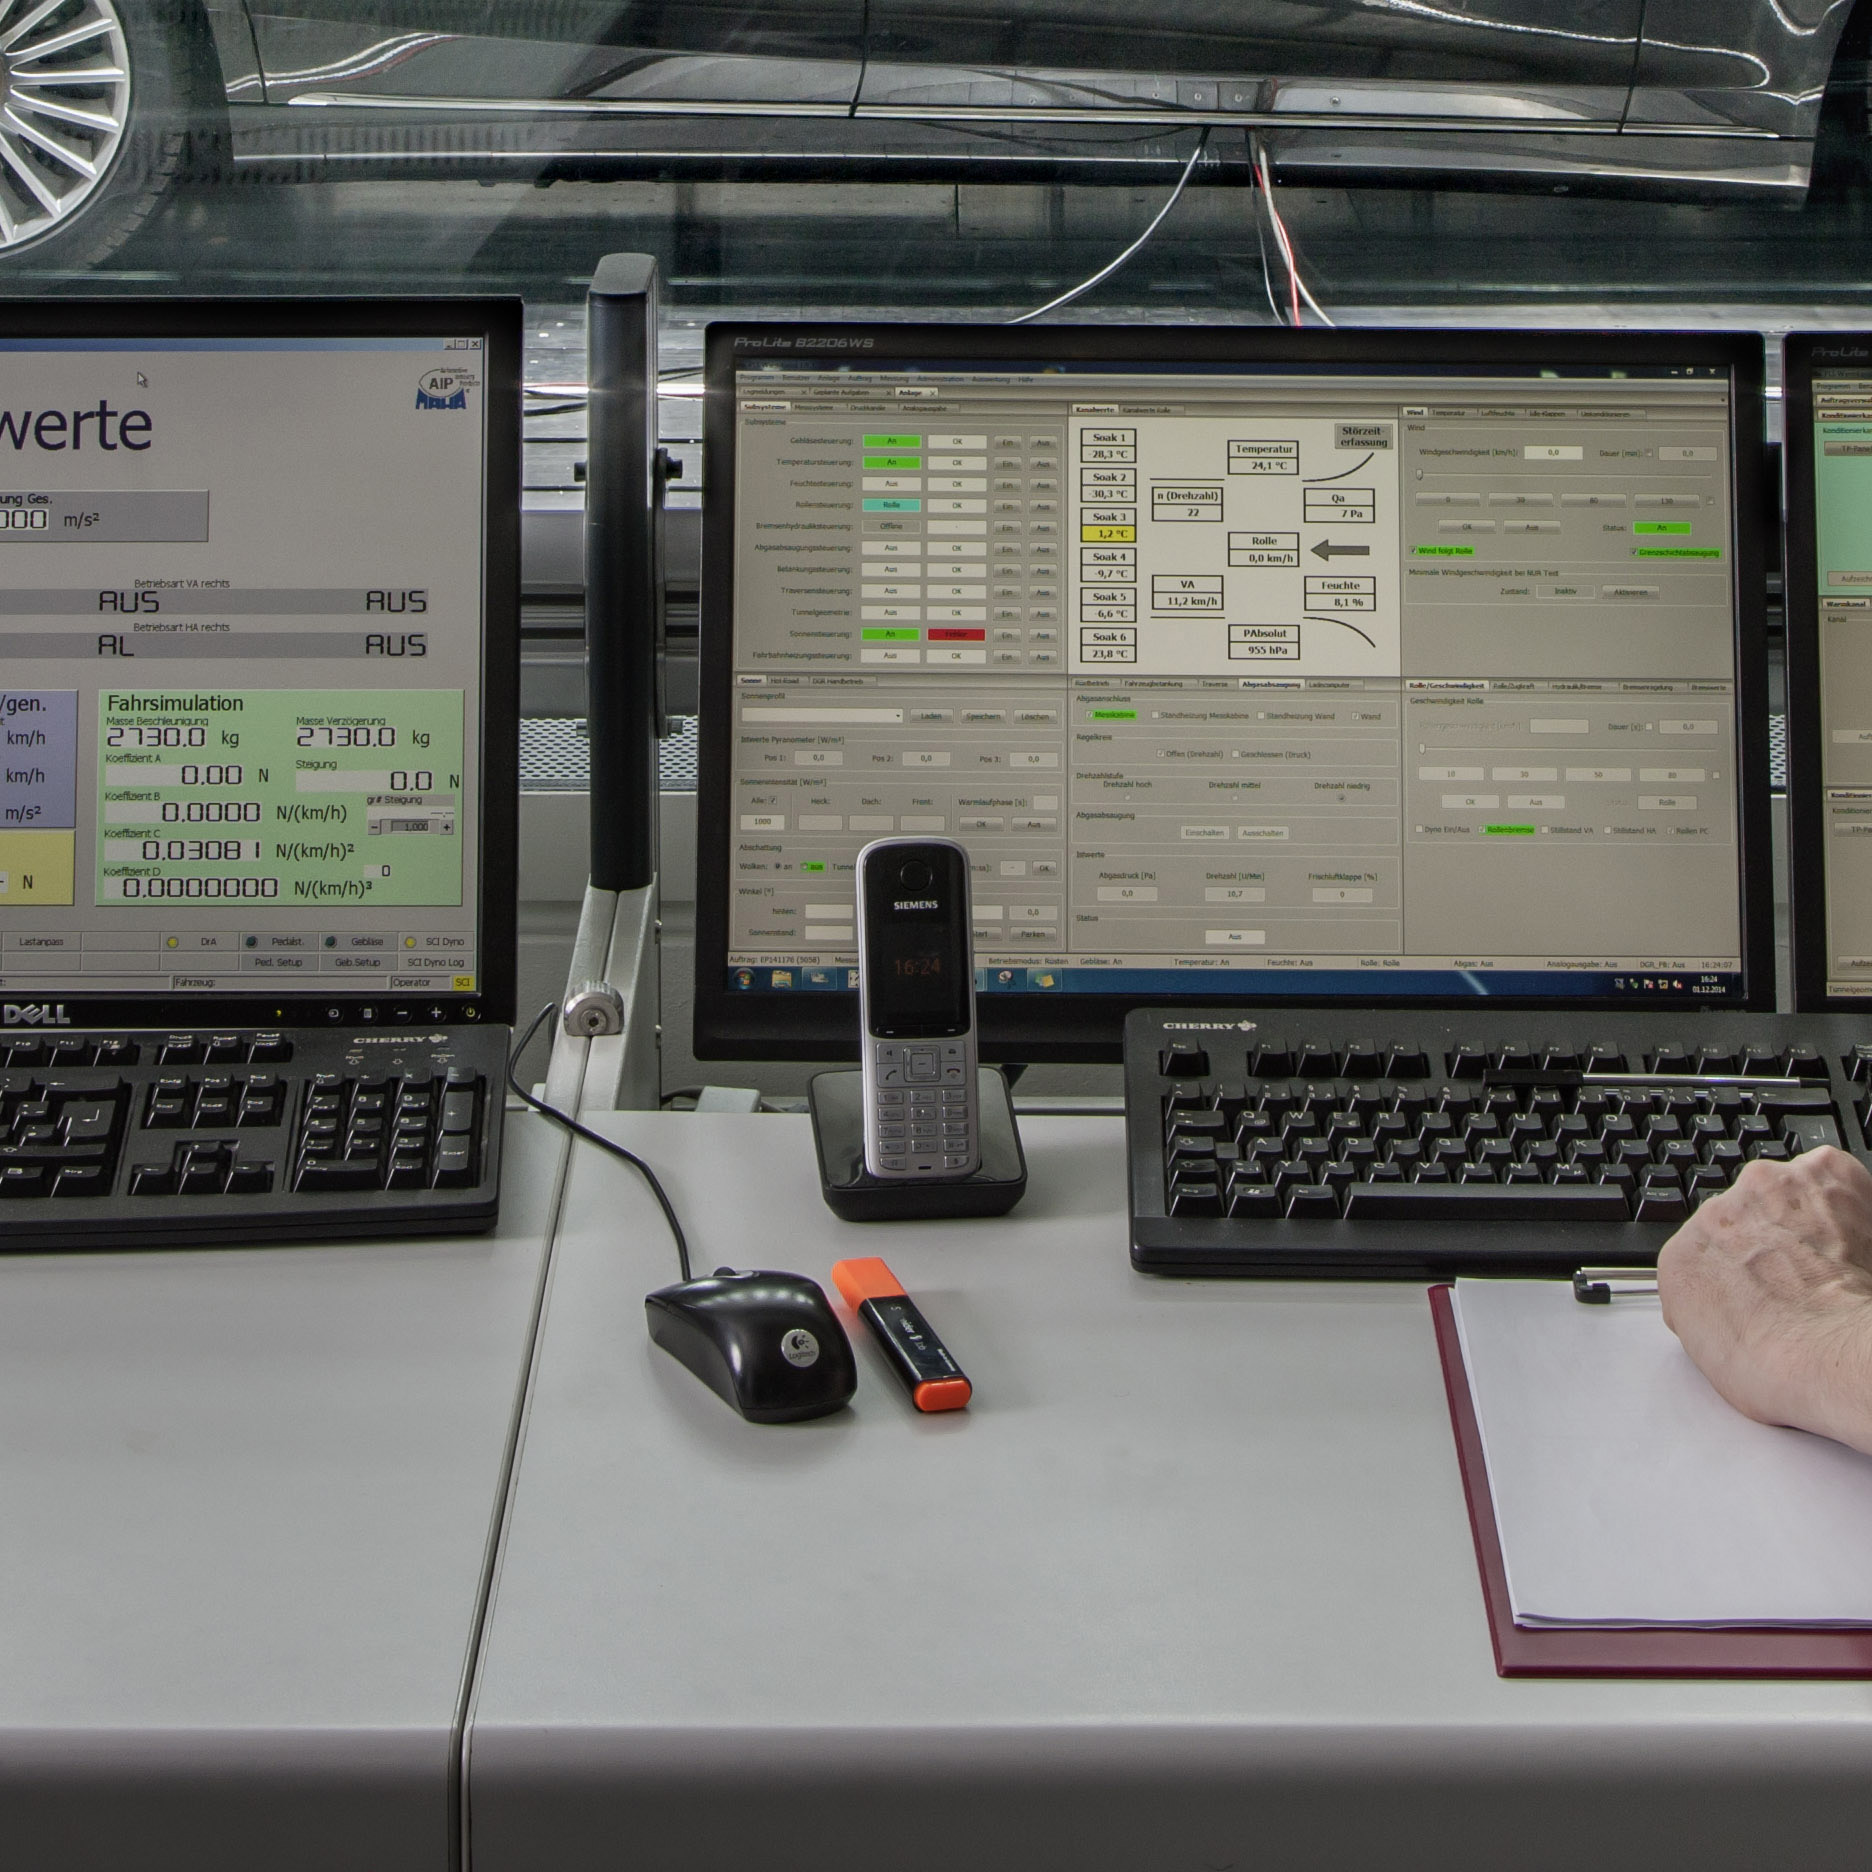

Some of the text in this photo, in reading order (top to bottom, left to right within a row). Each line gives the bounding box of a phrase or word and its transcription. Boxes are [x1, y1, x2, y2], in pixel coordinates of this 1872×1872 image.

[734, 337, 874, 348] ProLite B2206WS
[429, 378, 453, 389] AIP
[1342, 426, 1385, 436] Störzeit-
[1093, 433, 1118, 442] Soak
[1341, 437, 1388, 448] erfassung
[1237, 445, 1293, 455] Temperatur
[1251, 462, 1272, 471] 24,1
[28, 493, 53, 504] Ges.
[1167, 491, 1219, 502] (Drehzahl)
[1331, 494, 1345, 503] Qa
[1188, 508, 1200, 517] 22
[1350, 509, 1363, 518] Pa
[64, 513, 100, 528] m/s²
[1252, 536, 1277, 545] Rolle
[1249, 553, 1293, 564] 0,0 km/h
[1181, 581, 1195, 589] VA
[1322, 581, 1360, 590] Feuchte
[98, 591, 159, 612] AUS
[366, 590, 427, 613] AUS
[1167, 596, 1218, 607] 11,2 km/h
[1334, 598, 1363, 608] 8,1 %
[1243, 629, 1287, 638] PAbsolut
[365, 634, 426, 656] AUS
[1248, 645, 1287, 654] 955 hPa
[108, 695, 243, 712] Fahrsimulation
[7, 731, 45, 747] km/h
[221, 731, 239, 747] kg
[412, 731, 430, 747] kg
[6, 768, 45, 785] km/h
[259, 769, 268, 782] N
[449, 775, 459, 788] N
[6, 806, 41, 822] m/s²
[277, 805, 347, 822] N/(km/h)
[276, 843, 354, 861] N/(km/h)²
[295, 882, 372, 899] N/(km/h)³
[894, 900, 938, 910] SIEMENS
[894, 957, 942, 976] 16:24
[3, 1005, 70, 1023] DELL
[789, 1351, 816, 1360] Logitech
